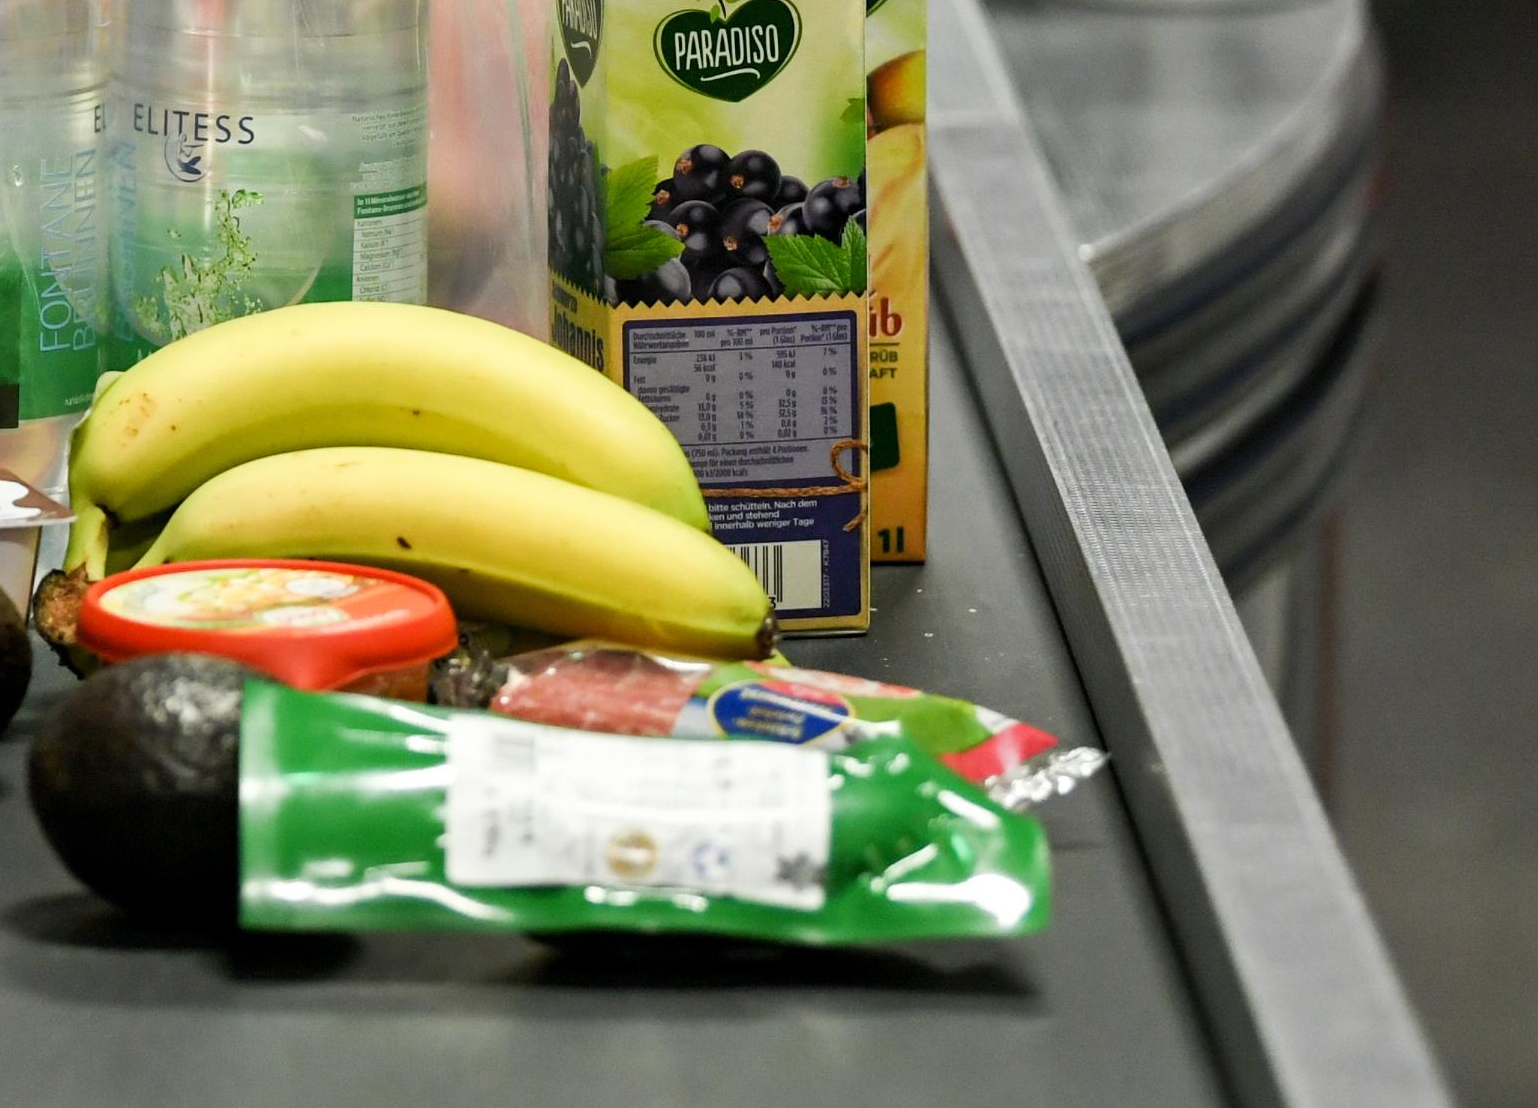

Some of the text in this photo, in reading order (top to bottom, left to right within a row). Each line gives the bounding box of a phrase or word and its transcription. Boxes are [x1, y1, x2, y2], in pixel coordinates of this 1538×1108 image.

[674, 24, 780, 70] PARADISO
[133, 103, 256, 144] ELITESS
[39, 155, 74, 352] FONTANE
[73, 149, 97, 352] BRUNNEN
[720, 339, 732, 347] pro
[744, 337, 754, 345] ml
[633, 356, 657, 365] Energie
[869, 368, 898, 379] AFT
[633, 376, 646, 384] Fett
[708, 502, 729, 512] bitte
[774, 500, 796, 508] Nach
[797, 499, 818, 508] dem
[726, 512, 744, 520] und
[745, 510, 780, 520] stehend
[714, 518, 815, 530] innerhalb weniger Tage
[768, 596, 776, 609] 3
